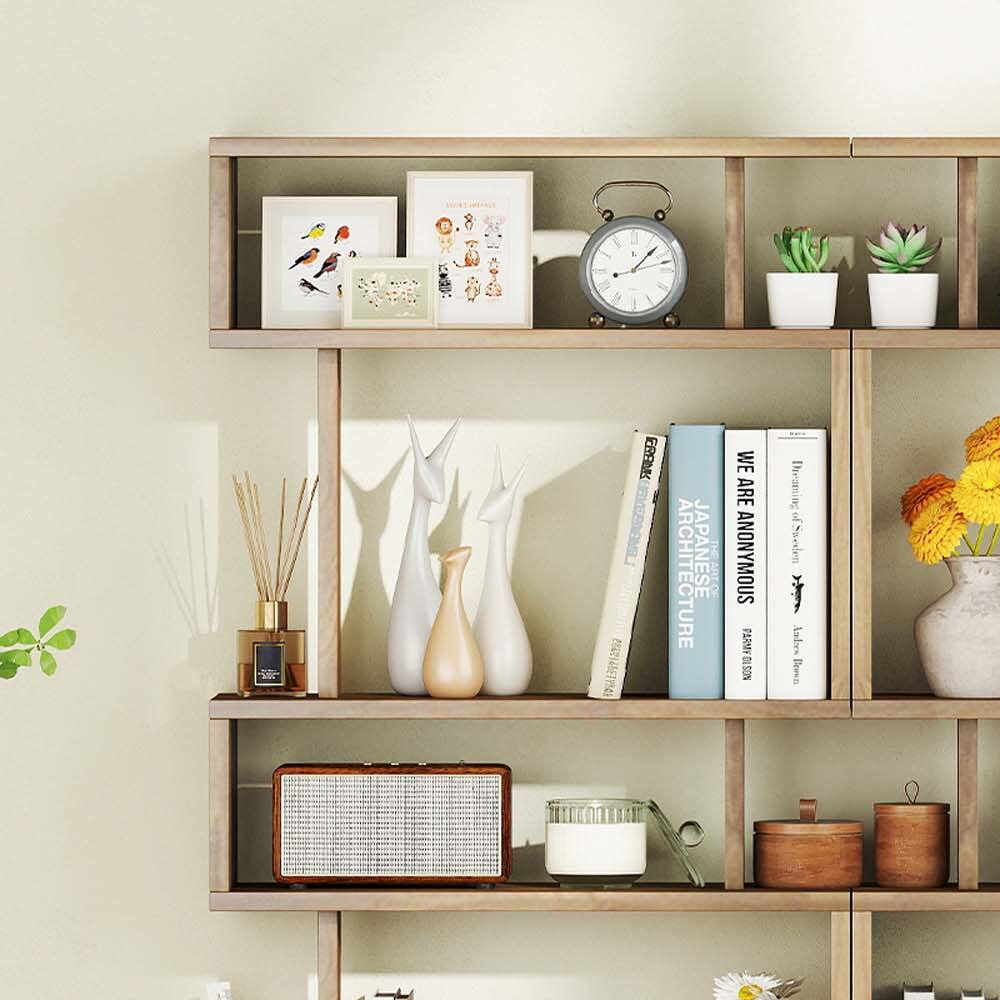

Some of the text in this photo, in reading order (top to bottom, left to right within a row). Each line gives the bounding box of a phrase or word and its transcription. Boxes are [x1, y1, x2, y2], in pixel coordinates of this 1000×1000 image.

[639, 436, 658, 480] FRANK
[694, 498, 711, 599] JAPANESE
[736, 450, 755, 605] WE ARE ANONYMOUS
[789, 460, 804, 565] Dreaming of Sweden
[677, 497, 695, 649] ARCHITECTURE
[710, 540, 720, 599] THE ART OF
[742, 627, 752, 681] PARMY OLSON
[792, 658, 804, 686] Brown
